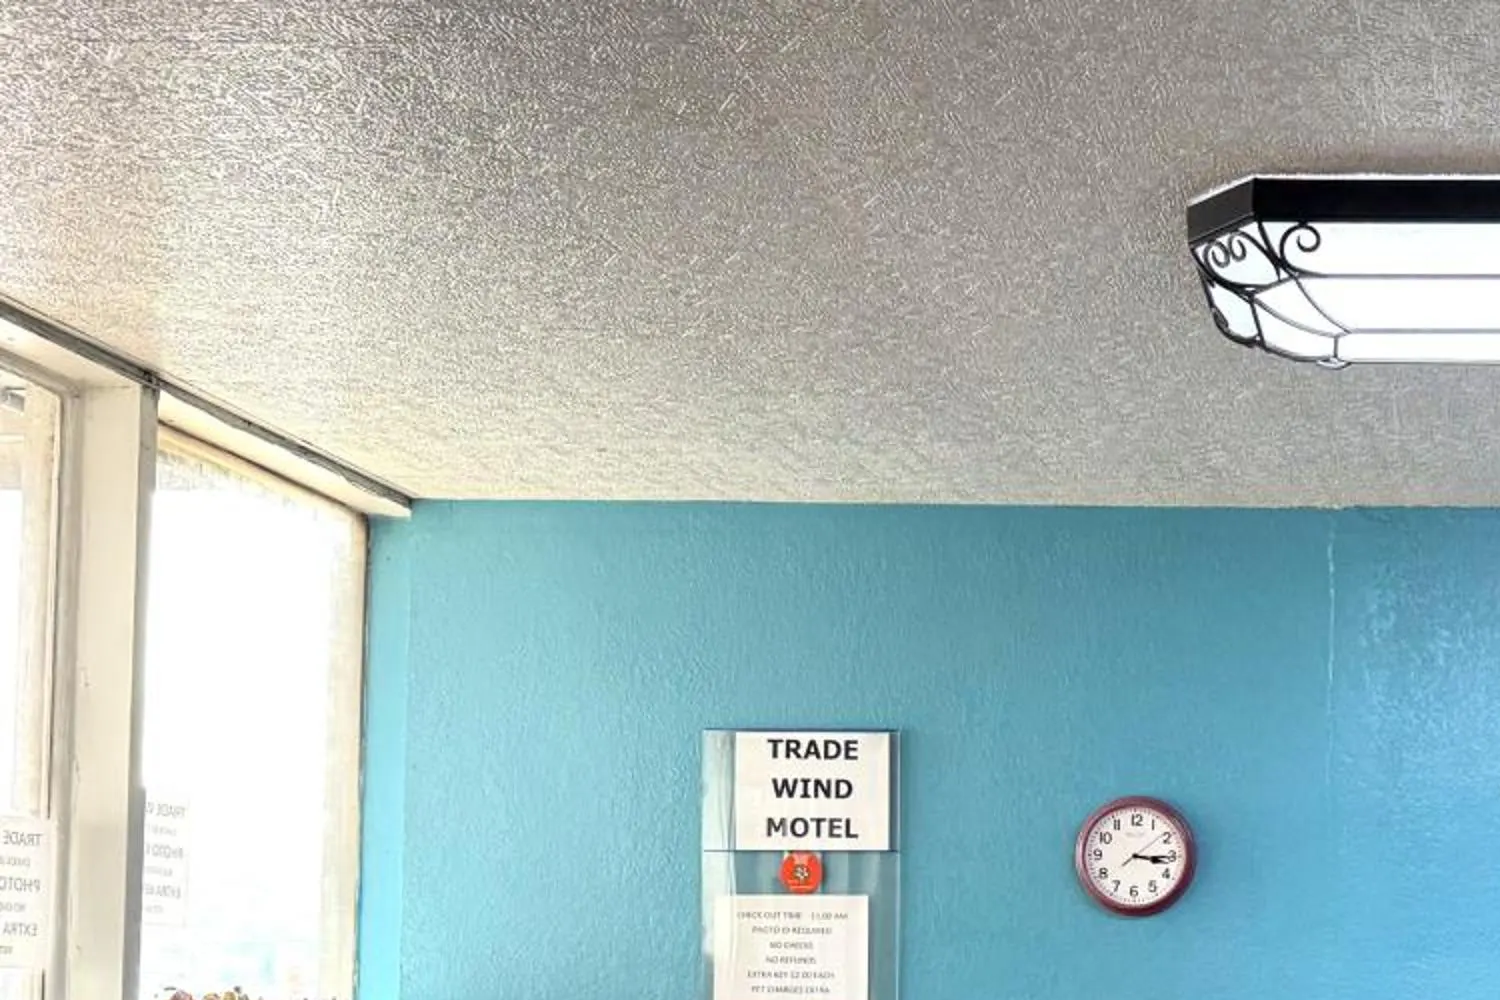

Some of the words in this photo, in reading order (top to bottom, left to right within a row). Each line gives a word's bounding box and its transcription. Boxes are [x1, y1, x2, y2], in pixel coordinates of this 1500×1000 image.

[767, 739, 859, 760] TRADE
[771, 778, 853, 799] WIND
[1113, 819, 1121, 831] 11
[1131, 813, 1143, 827] 12
[767, 817, 859, 839] MOTEL
[1099, 832, 1112, 845] 10
[1162, 832, 1172, 845] 2
[1093, 849, 1102, 861] 9
[1168, 850, 1176, 862] 3
[1099, 867, 1108, 879] 8
[1162, 868, 1170, 879] 4
[1111, 880, 1121, 892] 7
[1129, 885, 1139, 897] 6
[1148, 880, 1157, 892] 5
[769, 941, 782, 950] NO
[765, 955, 779, 964] NO
